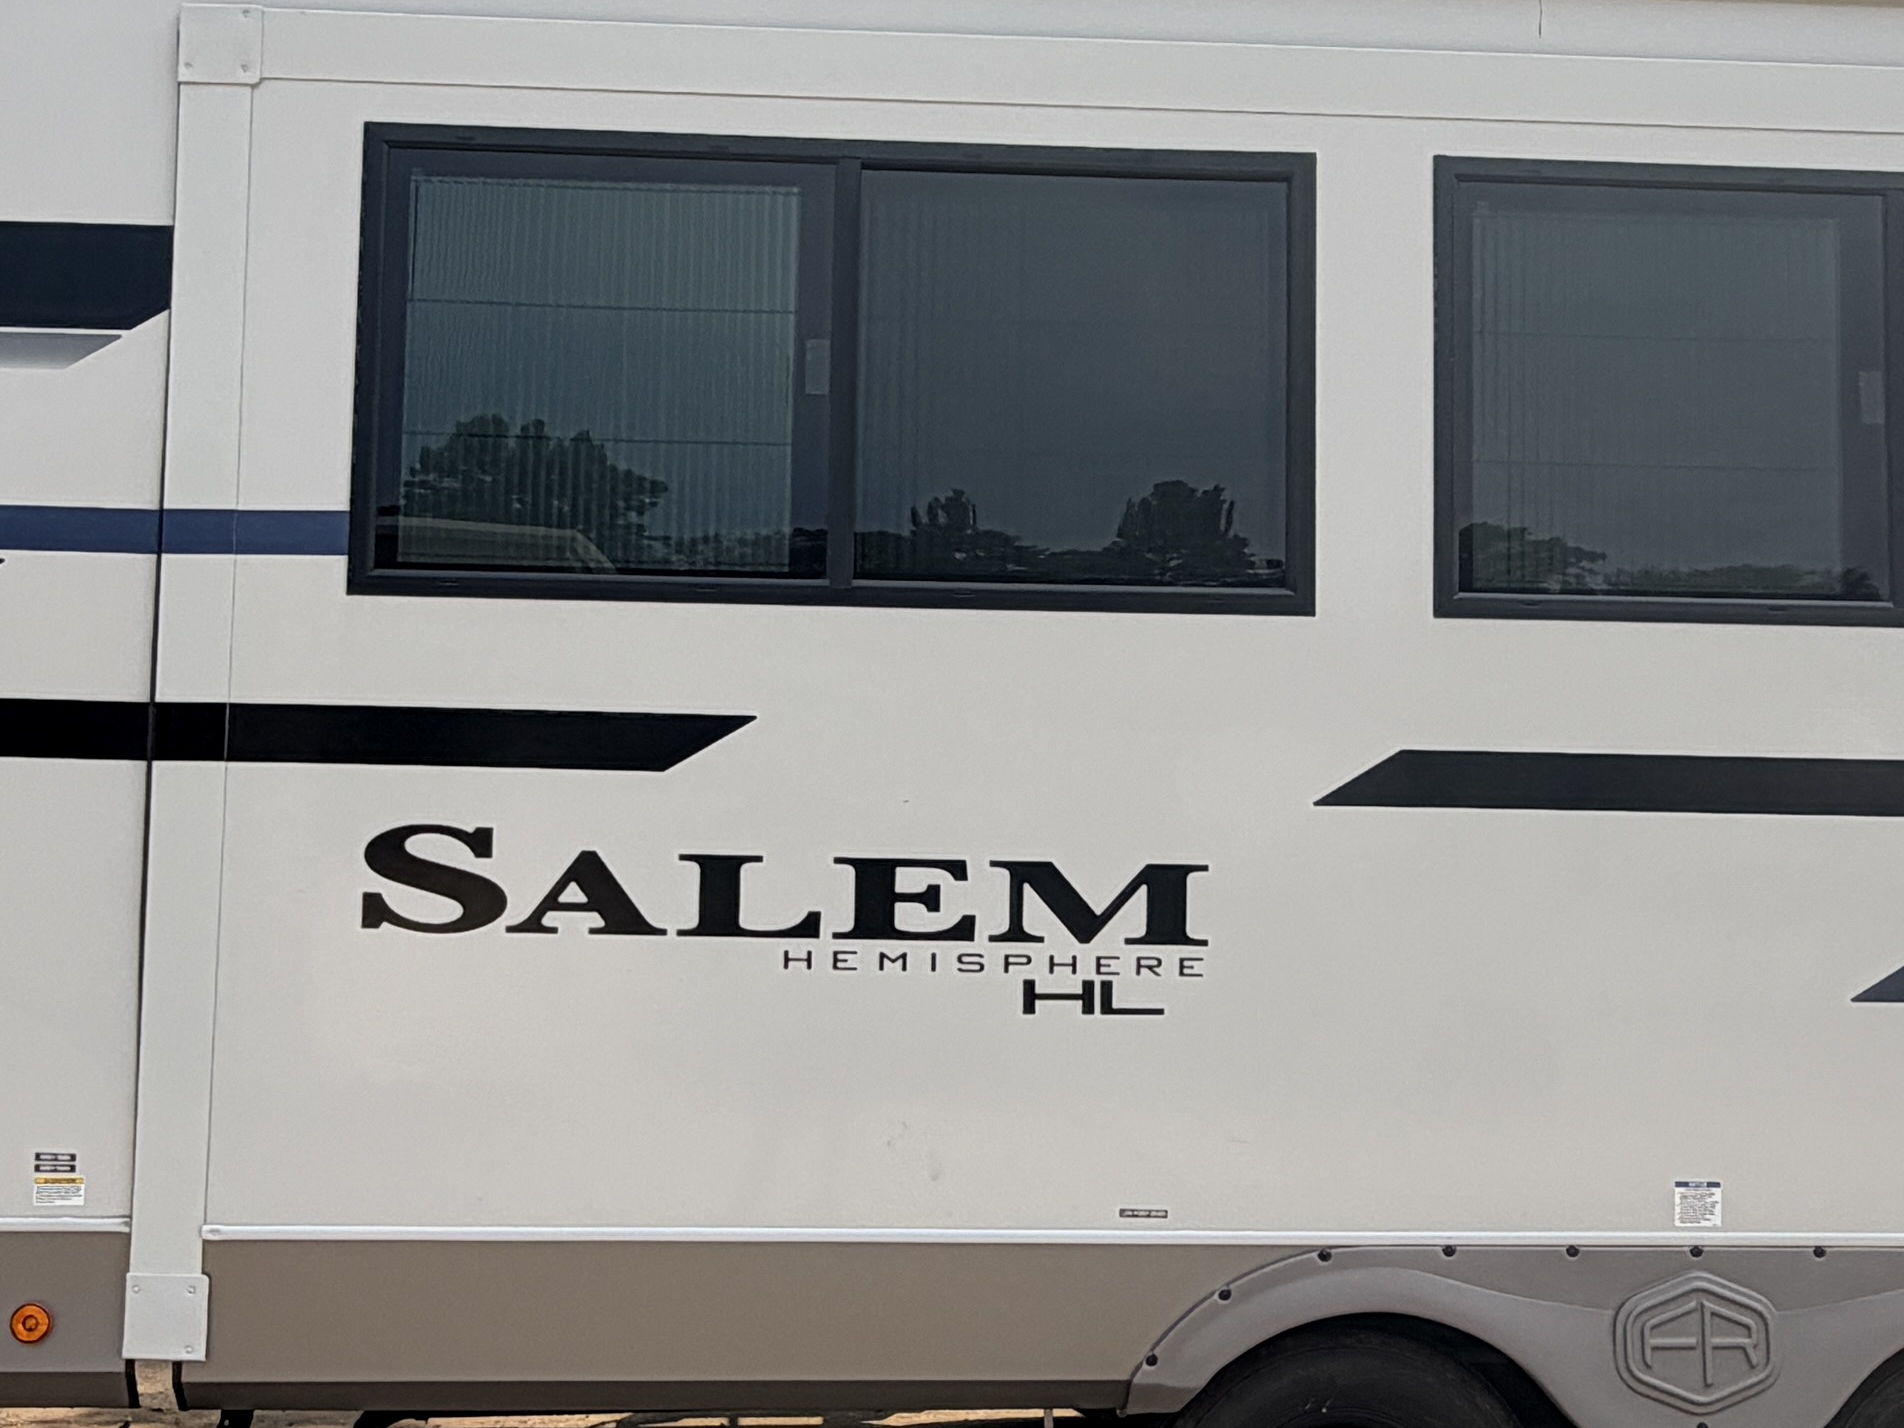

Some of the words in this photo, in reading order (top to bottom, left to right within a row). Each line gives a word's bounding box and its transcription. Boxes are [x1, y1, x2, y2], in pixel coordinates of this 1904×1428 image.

[360, 822, 1210, 947] SALEM
[782, 948, 1205, 978] HEMISPHERE
[1021, 979, 1166, 1016] HL
[1641, 1299, 1758, 1388] FR
